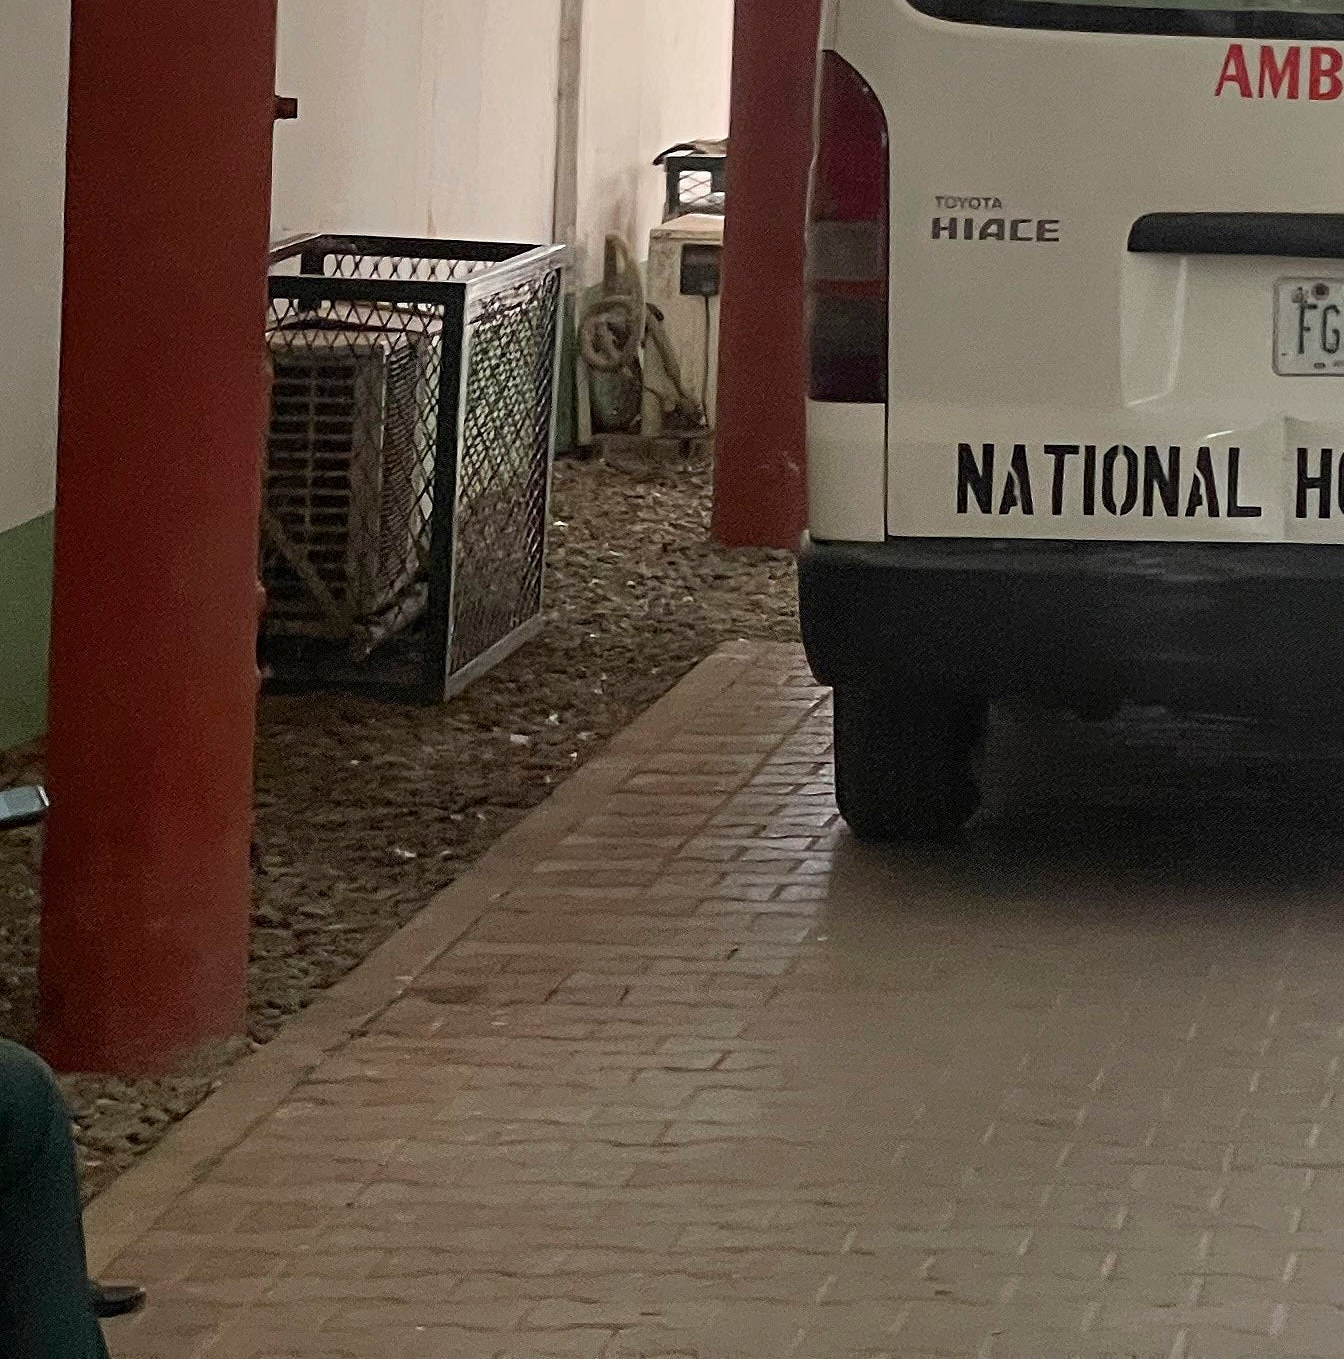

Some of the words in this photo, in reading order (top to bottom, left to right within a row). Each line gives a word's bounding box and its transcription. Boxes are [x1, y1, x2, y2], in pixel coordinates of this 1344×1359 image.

[934, 195, 1003, 211] TOYOTA
[931, 216, 1061, 243] HIACE
[956, 443, 1262, 518] NATIONAL
